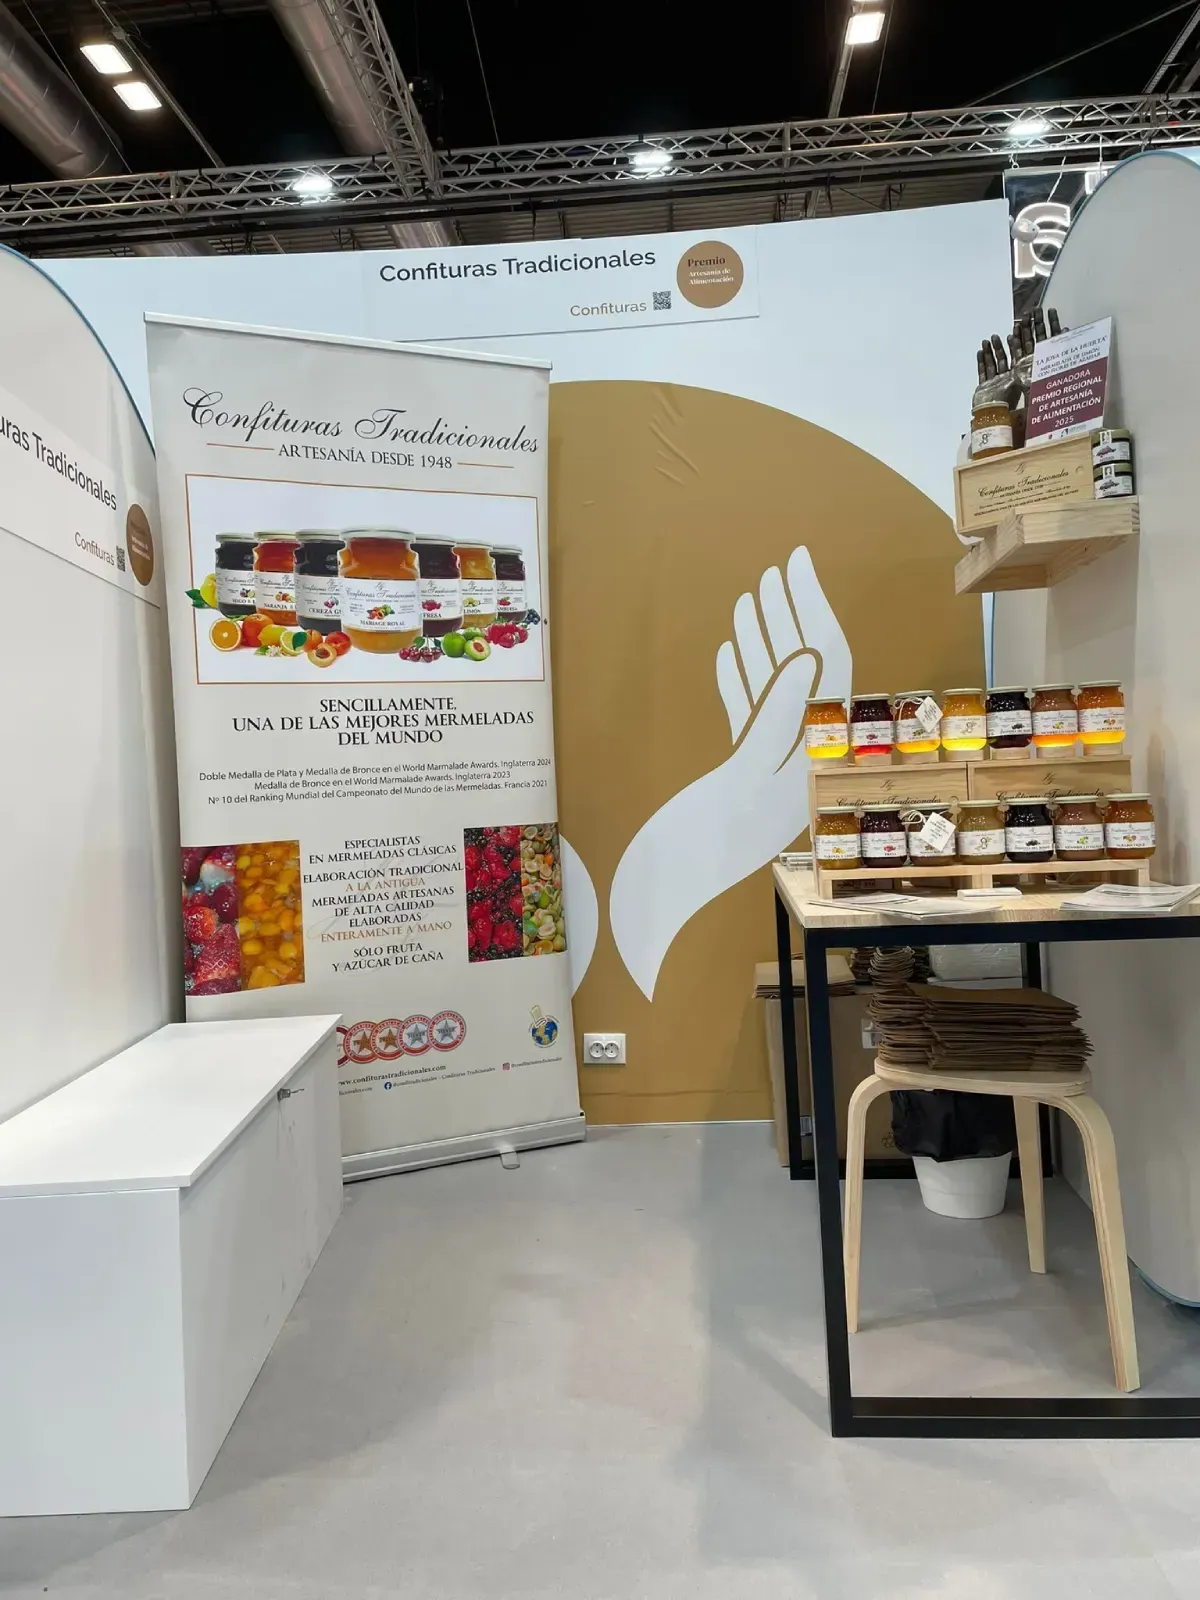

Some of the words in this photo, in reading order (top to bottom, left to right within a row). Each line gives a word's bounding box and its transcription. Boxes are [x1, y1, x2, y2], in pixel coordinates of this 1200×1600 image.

[379, 261, 497, 282] Confituras
[502, 250, 656, 276] Tradicionales
[687, 256, 726, 267] Premio
[570, 300, 647, 317] Confituras
[1046, 369, 1091, 390] GANADORA
[1031, 389, 1062, 405] PREMIO
[1063, 376, 1102, 394] REGIONAL
[1038, 404, 1049, 412] DE
[1050, 389, 1093, 408] ARTESANÍA
[183, 387, 343, 441] Confituras
[354, 408, 539, 453] Tradicionales
[1031, 416, 1043, 425] DE
[1043, 396, 1101, 421] ALIMENTACIÓN
[1054, 415, 1075, 428] 2025
[278, 445, 366, 463] ARTESANÍA
[371, 451, 415, 467] DESDE
[420, 455, 453, 469] 1948
[32, 432, 117, 511] Tradicionales
[75, 532, 115, 566] Confituras
[308, 607, 333, 615] CEREZA
[320, 697, 457, 713] SENCILLAMENTE,
[232, 716, 275, 732] UNA
[280, 716, 303, 731] DE
[309, 715, 340, 730] LAS
[345, 713, 419, 732] MEJORES
[424, 711, 535, 727] MERMELADAS
[338, 732, 369, 746] DEL
[375, 730, 443, 744] MUNDO
[199, 772, 226, 781] Doble
[228, 770, 262, 780] Medalla
[264, 769, 275, 778] de
[276, 768, 297, 778] Plata
[299, 770, 304, 778] y
[305, 767, 338, 776] Medalla
[340, 766, 351, 775] de
[352, 765, 381, 774] Bronce
[394, 764, 401, 773] el
[402, 763, 426, 772] World
[427, 762, 469, 771] Marmalade
[470, 760, 499, 770] Awards.
[501, 759, 536, 769] Inglaterra
[254, 782, 288, 790] Medalla
[289, 780, 300, 789] de
[302, 779, 330, 788] Bronce
[344, 778, 352, 786] el
[353, 777, 378, 785] World
[379, 775, 423, 785] Marmalade
[424, 774, 453, 782] Awards.
[455, 772, 491, 783] Inglaterra
[493, 771, 511, 780] 2023
[222, 796, 233, 804] 10
[234, 794, 248, 804] del
[249, 793, 284, 803] Ranking
[286, 790, 320, 801] Mundial
[321, 790, 335, 799] del
[336, 788, 389, 798] Campeonato
[390, 786, 402, 796] del
[404, 784, 432, 795] Mundo
[433, 783, 443, 793] de
[444, 783, 455, 792] las
[456, 781, 503, 792] Mermeladas.
[504, 780, 531, 789] Francia
[532, 779, 548, 788] 2021
[344, 835, 421, 849] ESPECIALISTAS
[309, 854, 324, 864] EN
[327, 848, 404, 863] MERMELADAS
[407, 844, 457, 857] CLÁSICAS
[303, 868, 385, 884] ELABORACIÓN
[389, 862, 464, 877] TRADICIONAL
[345, 884, 354, 892] A
[357, 882, 371, 891] LA
[375, 877, 426, 890] ANTIGUA
[312, 892, 390, 907] MERMELADAS
[393, 886, 455, 900] ARTESANAS
[335, 906, 349, 917] DE
[353, 903, 382, 915] ALTA
[385, 900, 435, 913] CALIDAD
[349, 912, 422, 928] ELABORADAS
[321, 926, 403, 943] ENTERAMENTE
[406, 924, 414, 933] A
[417, 920, 452, 933] MANO
[353, 944, 384, 958] SÓLO
[387, 942, 423, 954] FRUTA
[332, 963, 342, 972] Y
[343, 957, 391, 972] AZÚCAR
[395, 955, 410, 966] DE
[412, 951, 444, 963] CAÑA
[338, 1065, 447, 1086] ww.confiturastradicionales.com
